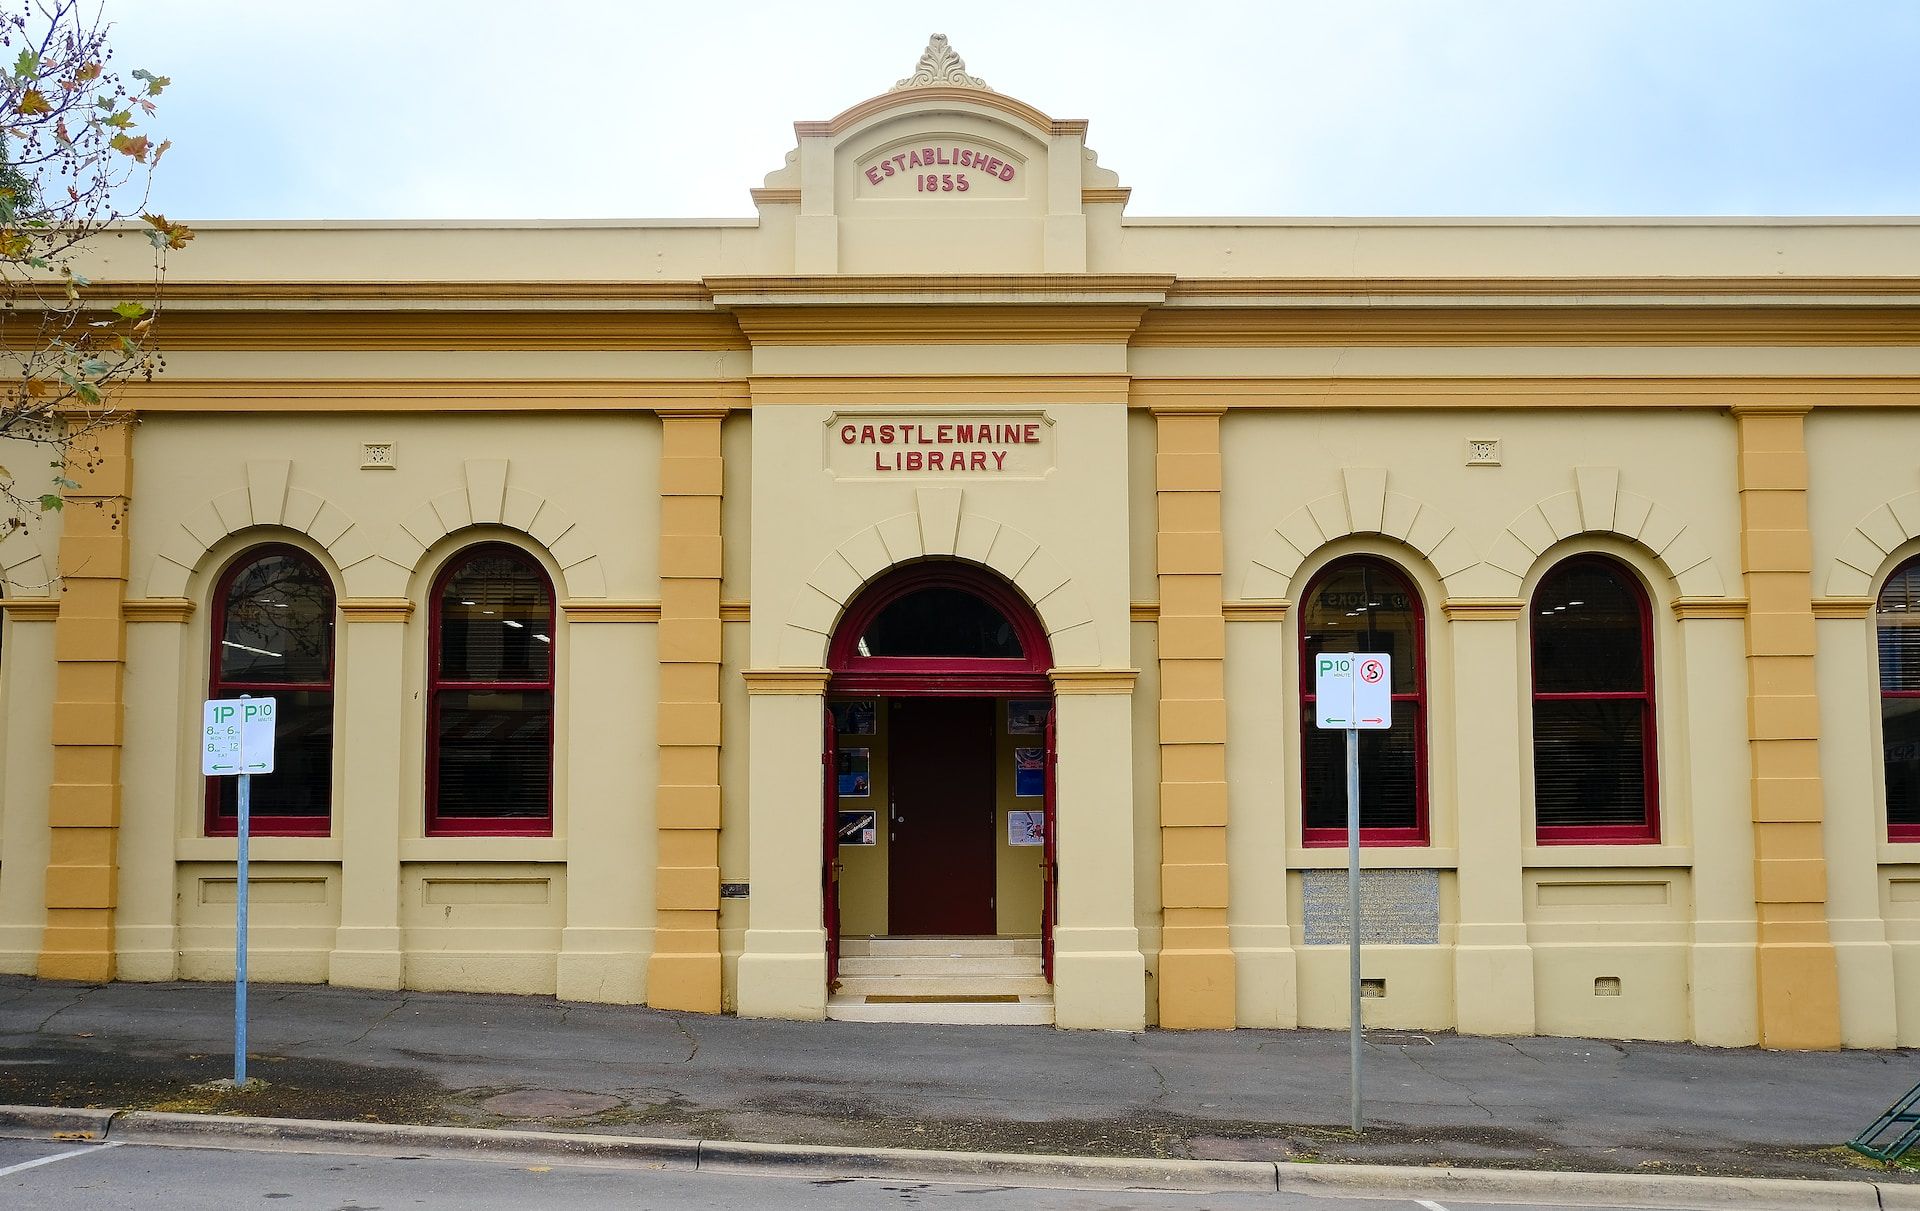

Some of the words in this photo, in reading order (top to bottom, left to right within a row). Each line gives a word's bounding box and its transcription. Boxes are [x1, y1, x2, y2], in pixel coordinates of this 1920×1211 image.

[865, 147, 1015, 186] ESTABLISHED
[917, 174, 970, 192] 1855
[841, 424, 1040, 444] CASTLEMAINE
[875, 450, 1008, 471] LIBRARY
[213, 706, 234, 723] 1P
